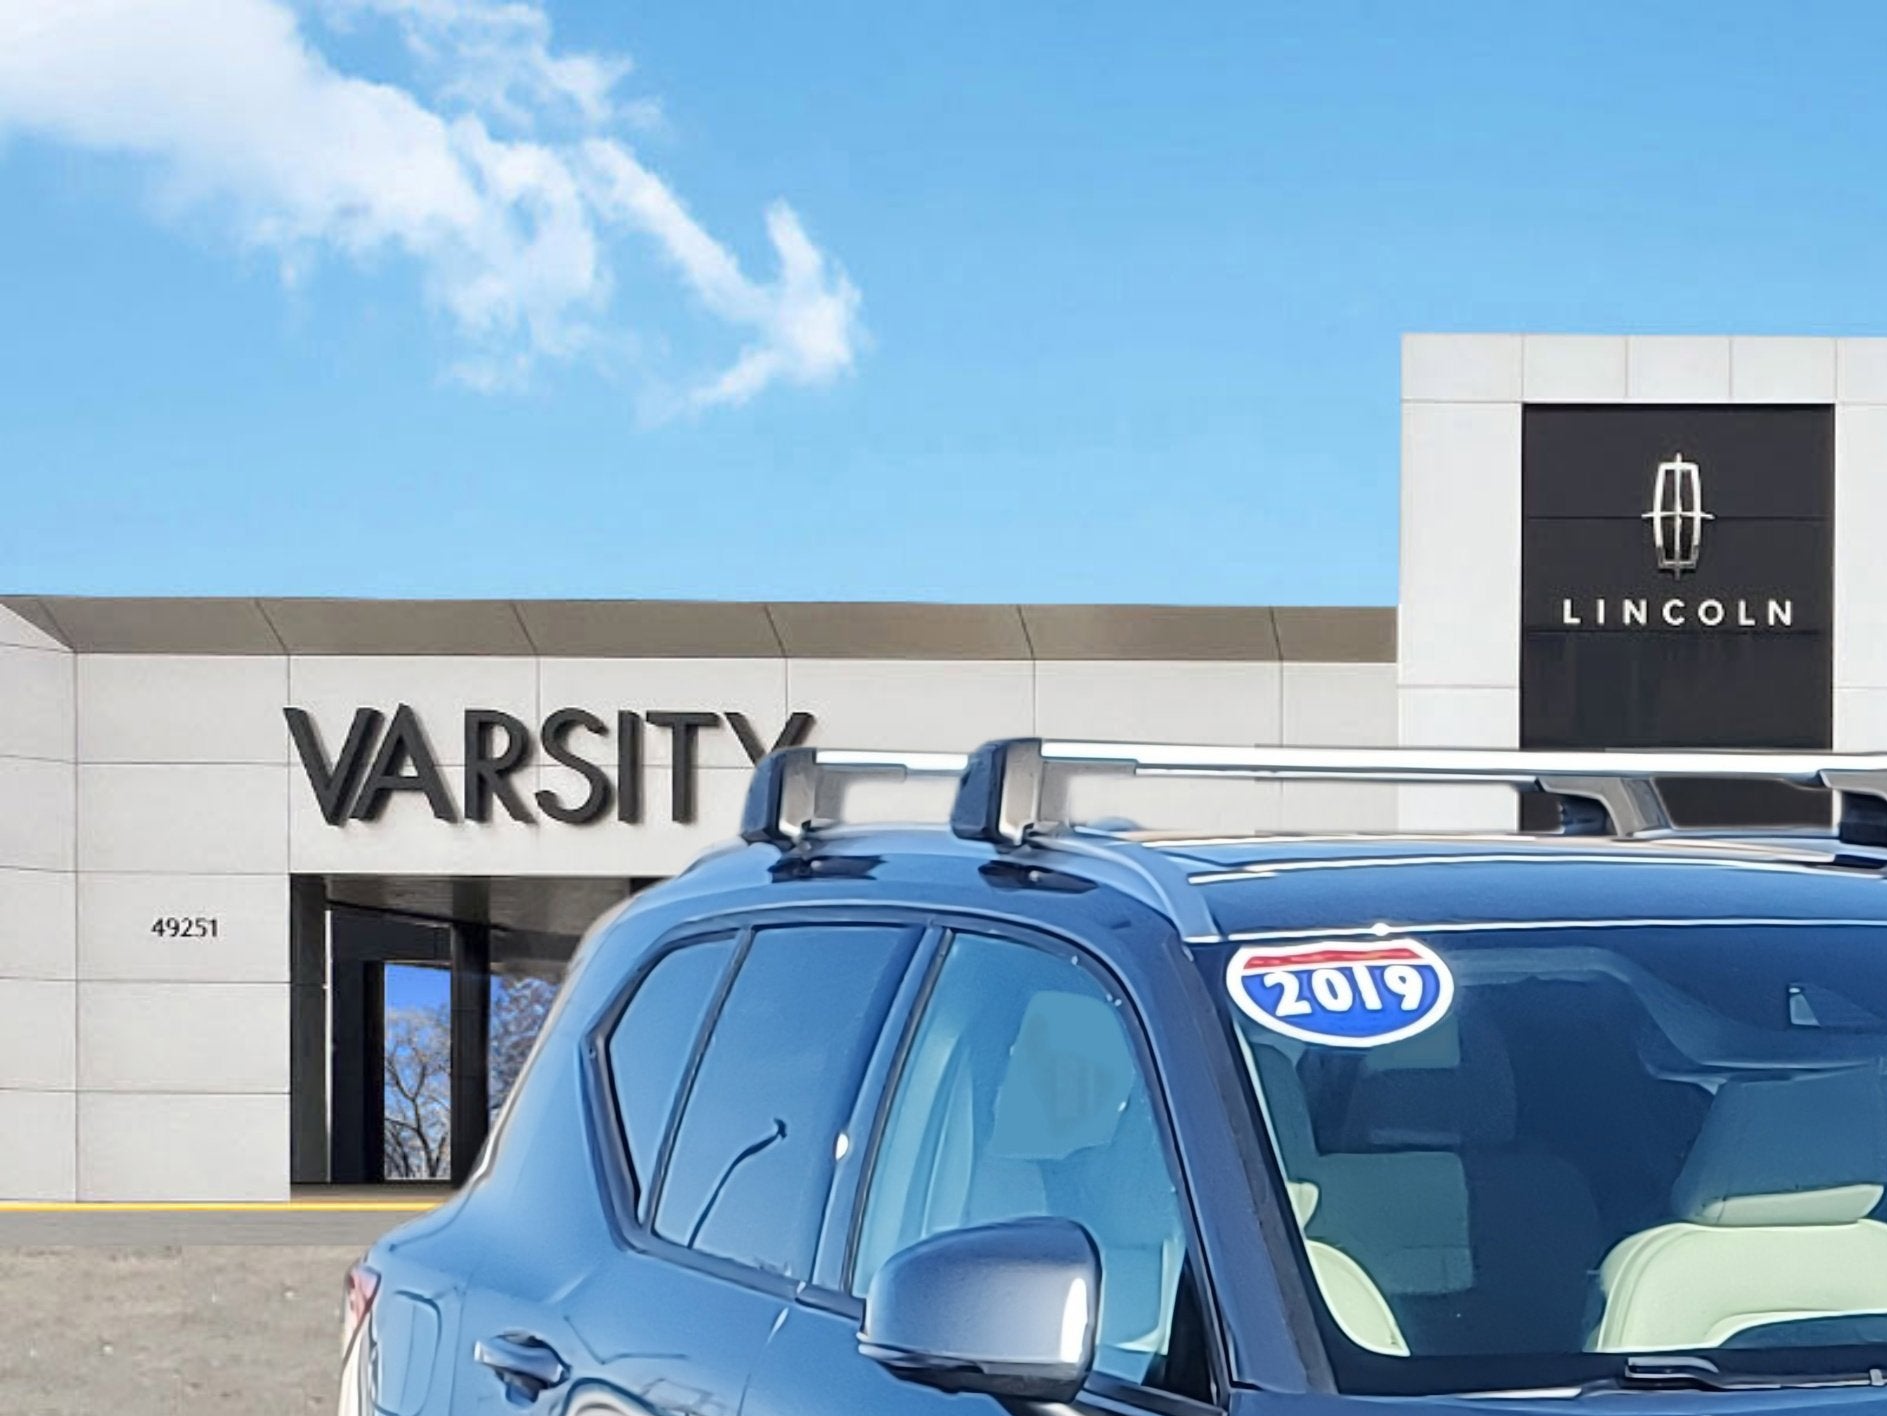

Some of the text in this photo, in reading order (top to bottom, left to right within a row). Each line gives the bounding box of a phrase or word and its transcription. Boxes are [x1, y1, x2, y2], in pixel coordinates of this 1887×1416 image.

[1562, 598, 1792, 626] LINCOLN
[284, 703, 817, 826] VARSITY
[151, 917, 219, 938] 49251
[1262, 964, 1424, 1017] 2019
